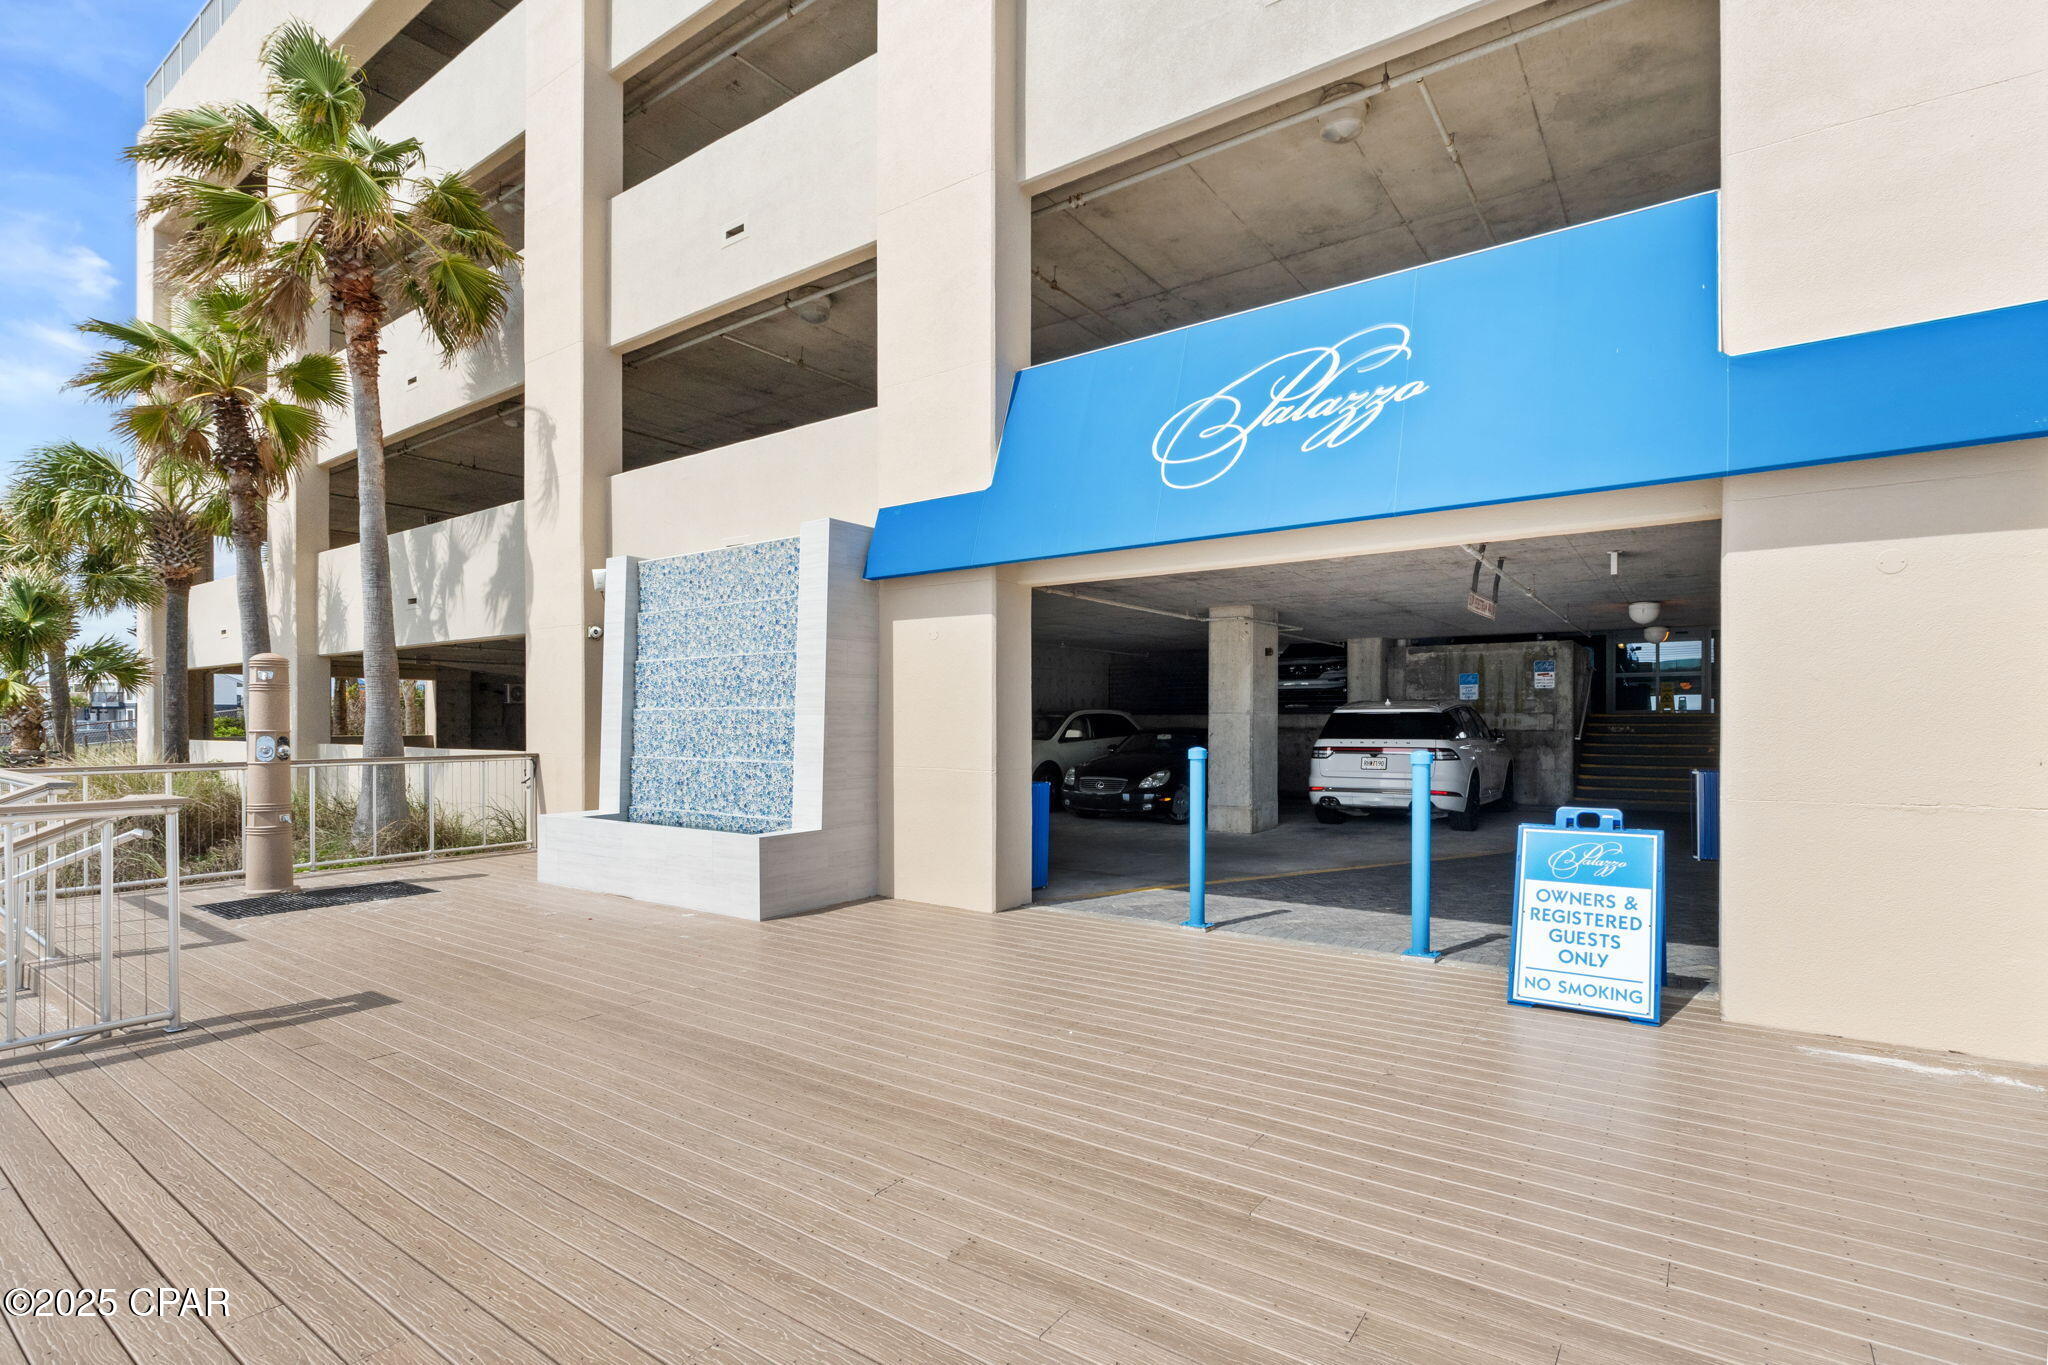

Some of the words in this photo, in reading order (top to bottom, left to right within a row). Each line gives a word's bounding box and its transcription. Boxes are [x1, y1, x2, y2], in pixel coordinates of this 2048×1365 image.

[1152, 324, 1430, 489] Palazzo
[1548, 841, 1628, 879] Palazzo
[1536, 888, 1616, 909] OWNERS
[1624, 896, 1639, 911] &
[1530, 907, 1643, 931] REGISTERED
[1549, 929, 1621, 949] GUESTS
[1558, 949, 1609, 968] ONLY
[1524, 976, 1551, 990] NO
[1558, 980, 1643, 1004] SMOKING
